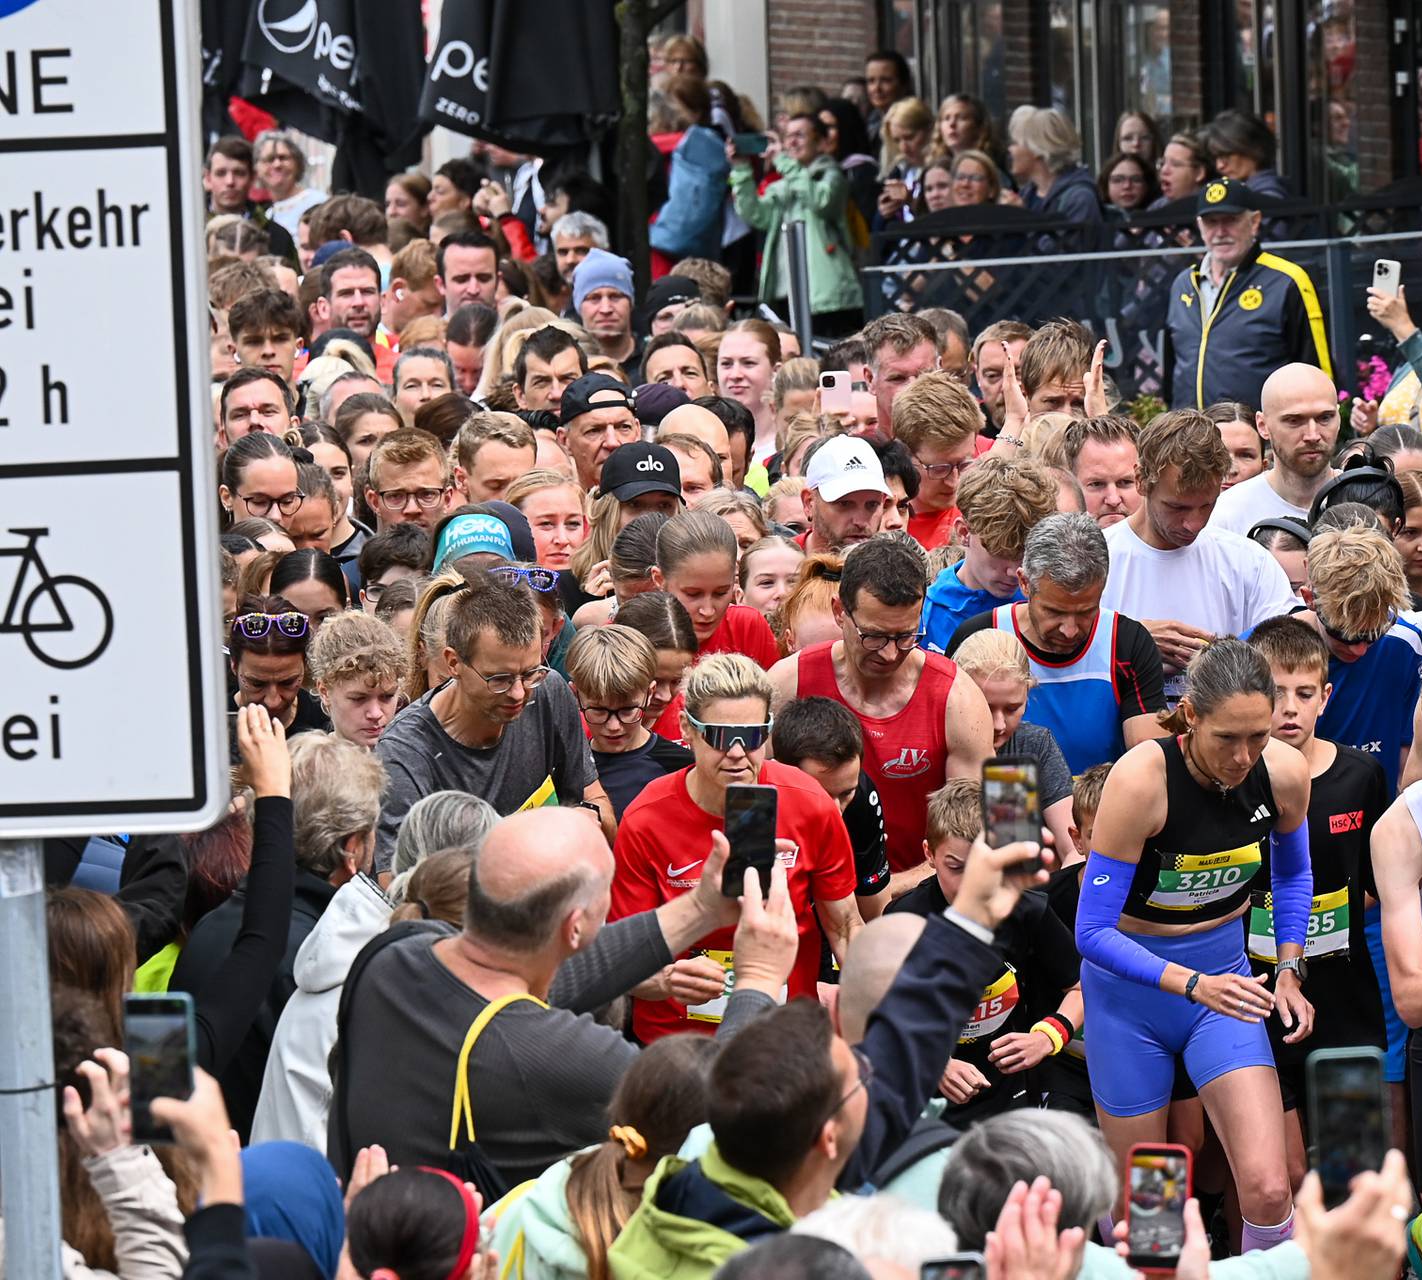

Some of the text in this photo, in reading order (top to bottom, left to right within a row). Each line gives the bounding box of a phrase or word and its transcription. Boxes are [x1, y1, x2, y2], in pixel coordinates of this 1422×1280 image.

[435, 97, 480, 125] ZERO
[0, 188, 150, 252] rkehr
[636, 454, 664, 471] alo
[445, 519, 507, 547] HOKA
[2, 695, 61, 761] ei
[896, 747, 929, 767] LV
[1331, 820, 1348, 829] HSC
[1176, 866, 1241, 892] 3210
